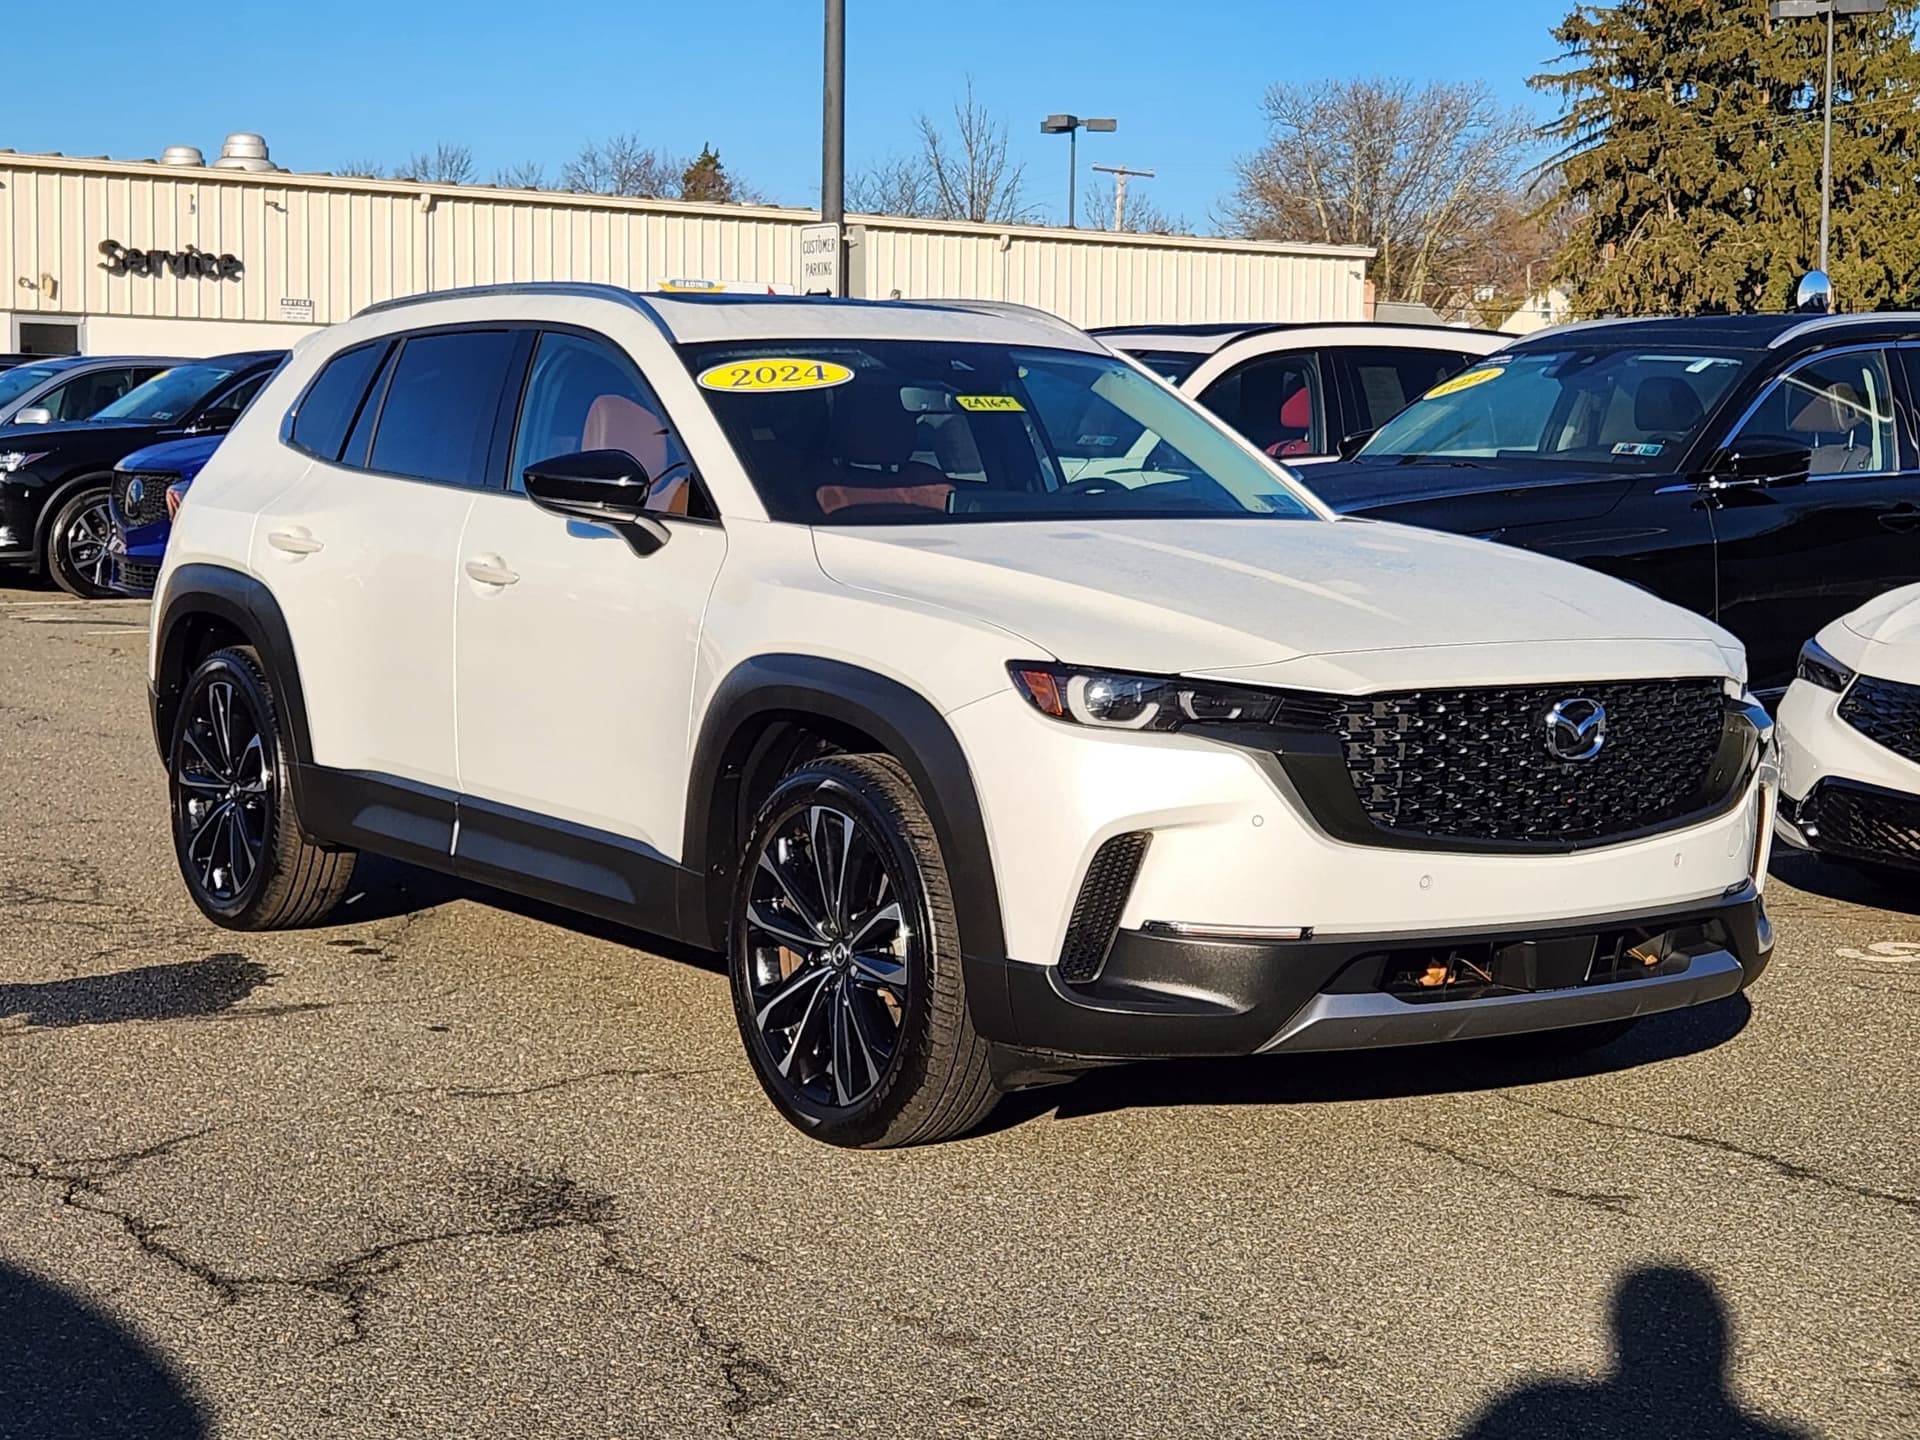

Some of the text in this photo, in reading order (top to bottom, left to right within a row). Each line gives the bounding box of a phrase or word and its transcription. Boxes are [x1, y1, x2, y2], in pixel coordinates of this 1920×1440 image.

[802, 237, 835, 254] CUSTOMER
[97, 239, 244, 283] Service
[805, 261, 832, 276] PARKING
[731, 363, 829, 387] 2024
[963, 398, 1011, 408] 24164
